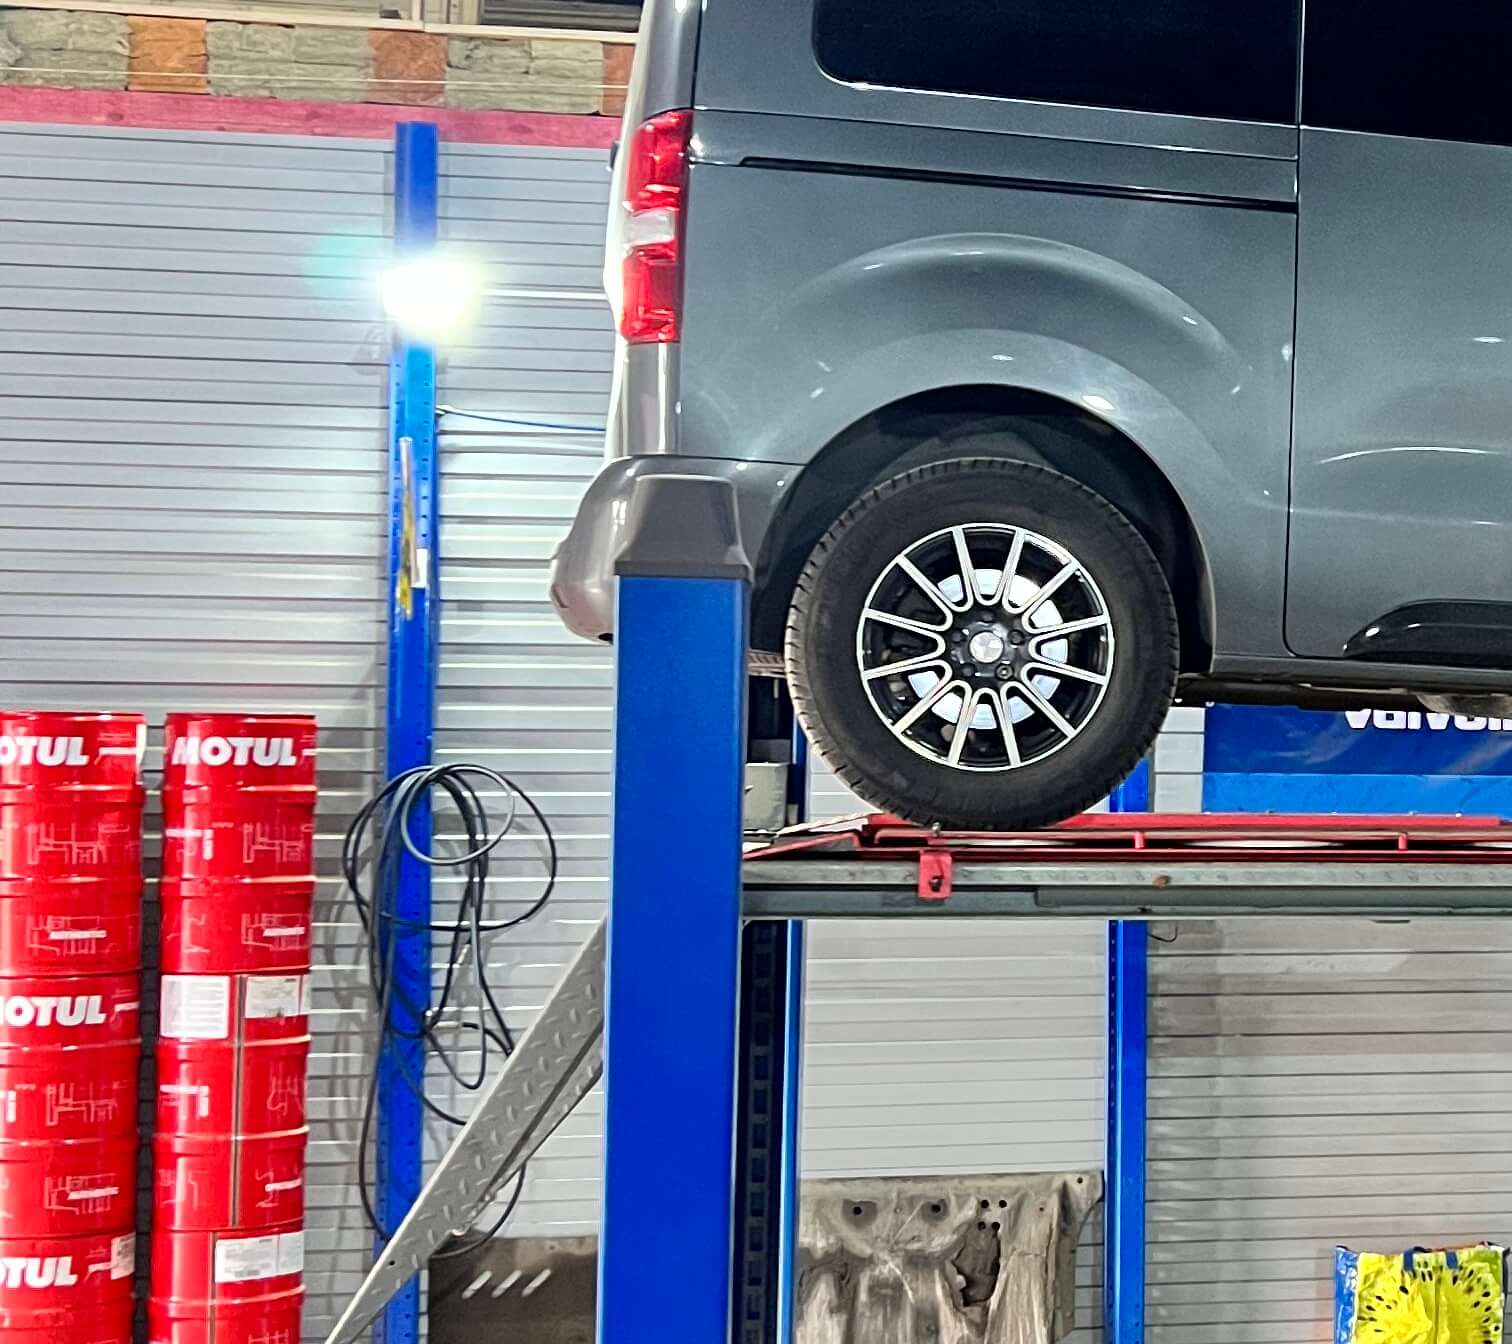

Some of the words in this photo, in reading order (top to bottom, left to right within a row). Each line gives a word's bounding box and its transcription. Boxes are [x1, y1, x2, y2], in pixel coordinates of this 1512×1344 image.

[0, 736, 89, 766] OTUL
[171, 737, 298, 767] MOTUL
[0, 995, 106, 1027] OTUL
